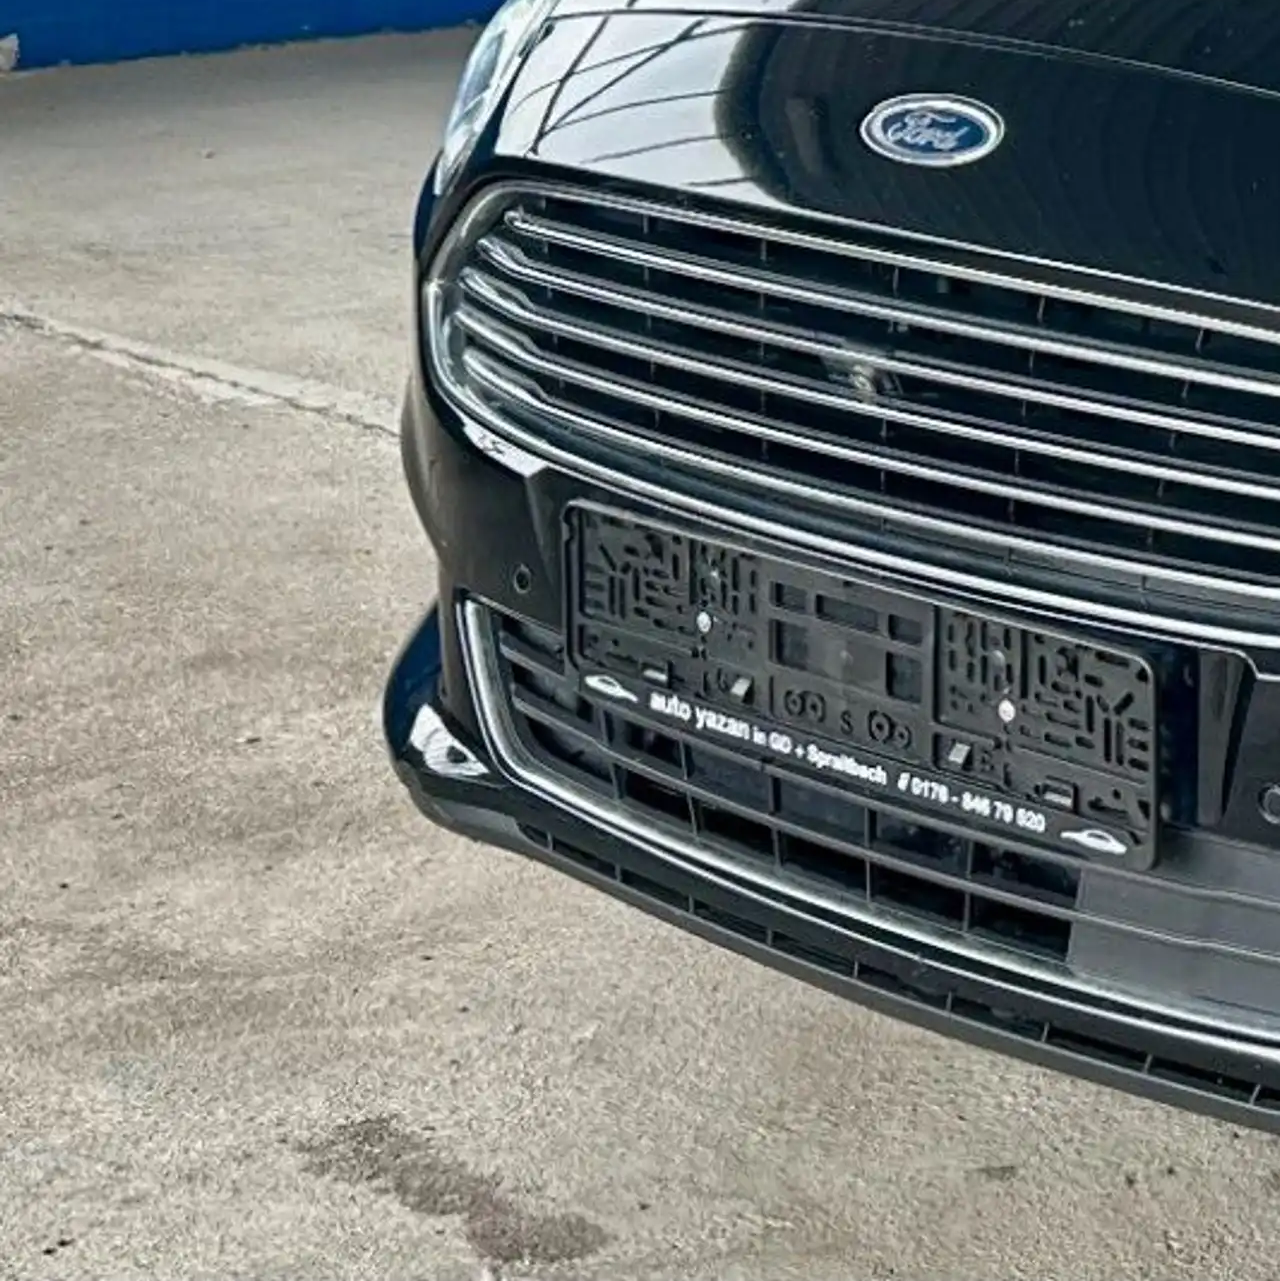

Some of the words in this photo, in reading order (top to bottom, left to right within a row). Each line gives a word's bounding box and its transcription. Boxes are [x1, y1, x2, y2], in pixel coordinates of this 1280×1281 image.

[887, 110, 970, 151] Ford
[651, 692, 692, 721] auto
[696, 705, 750, 740] yazan
